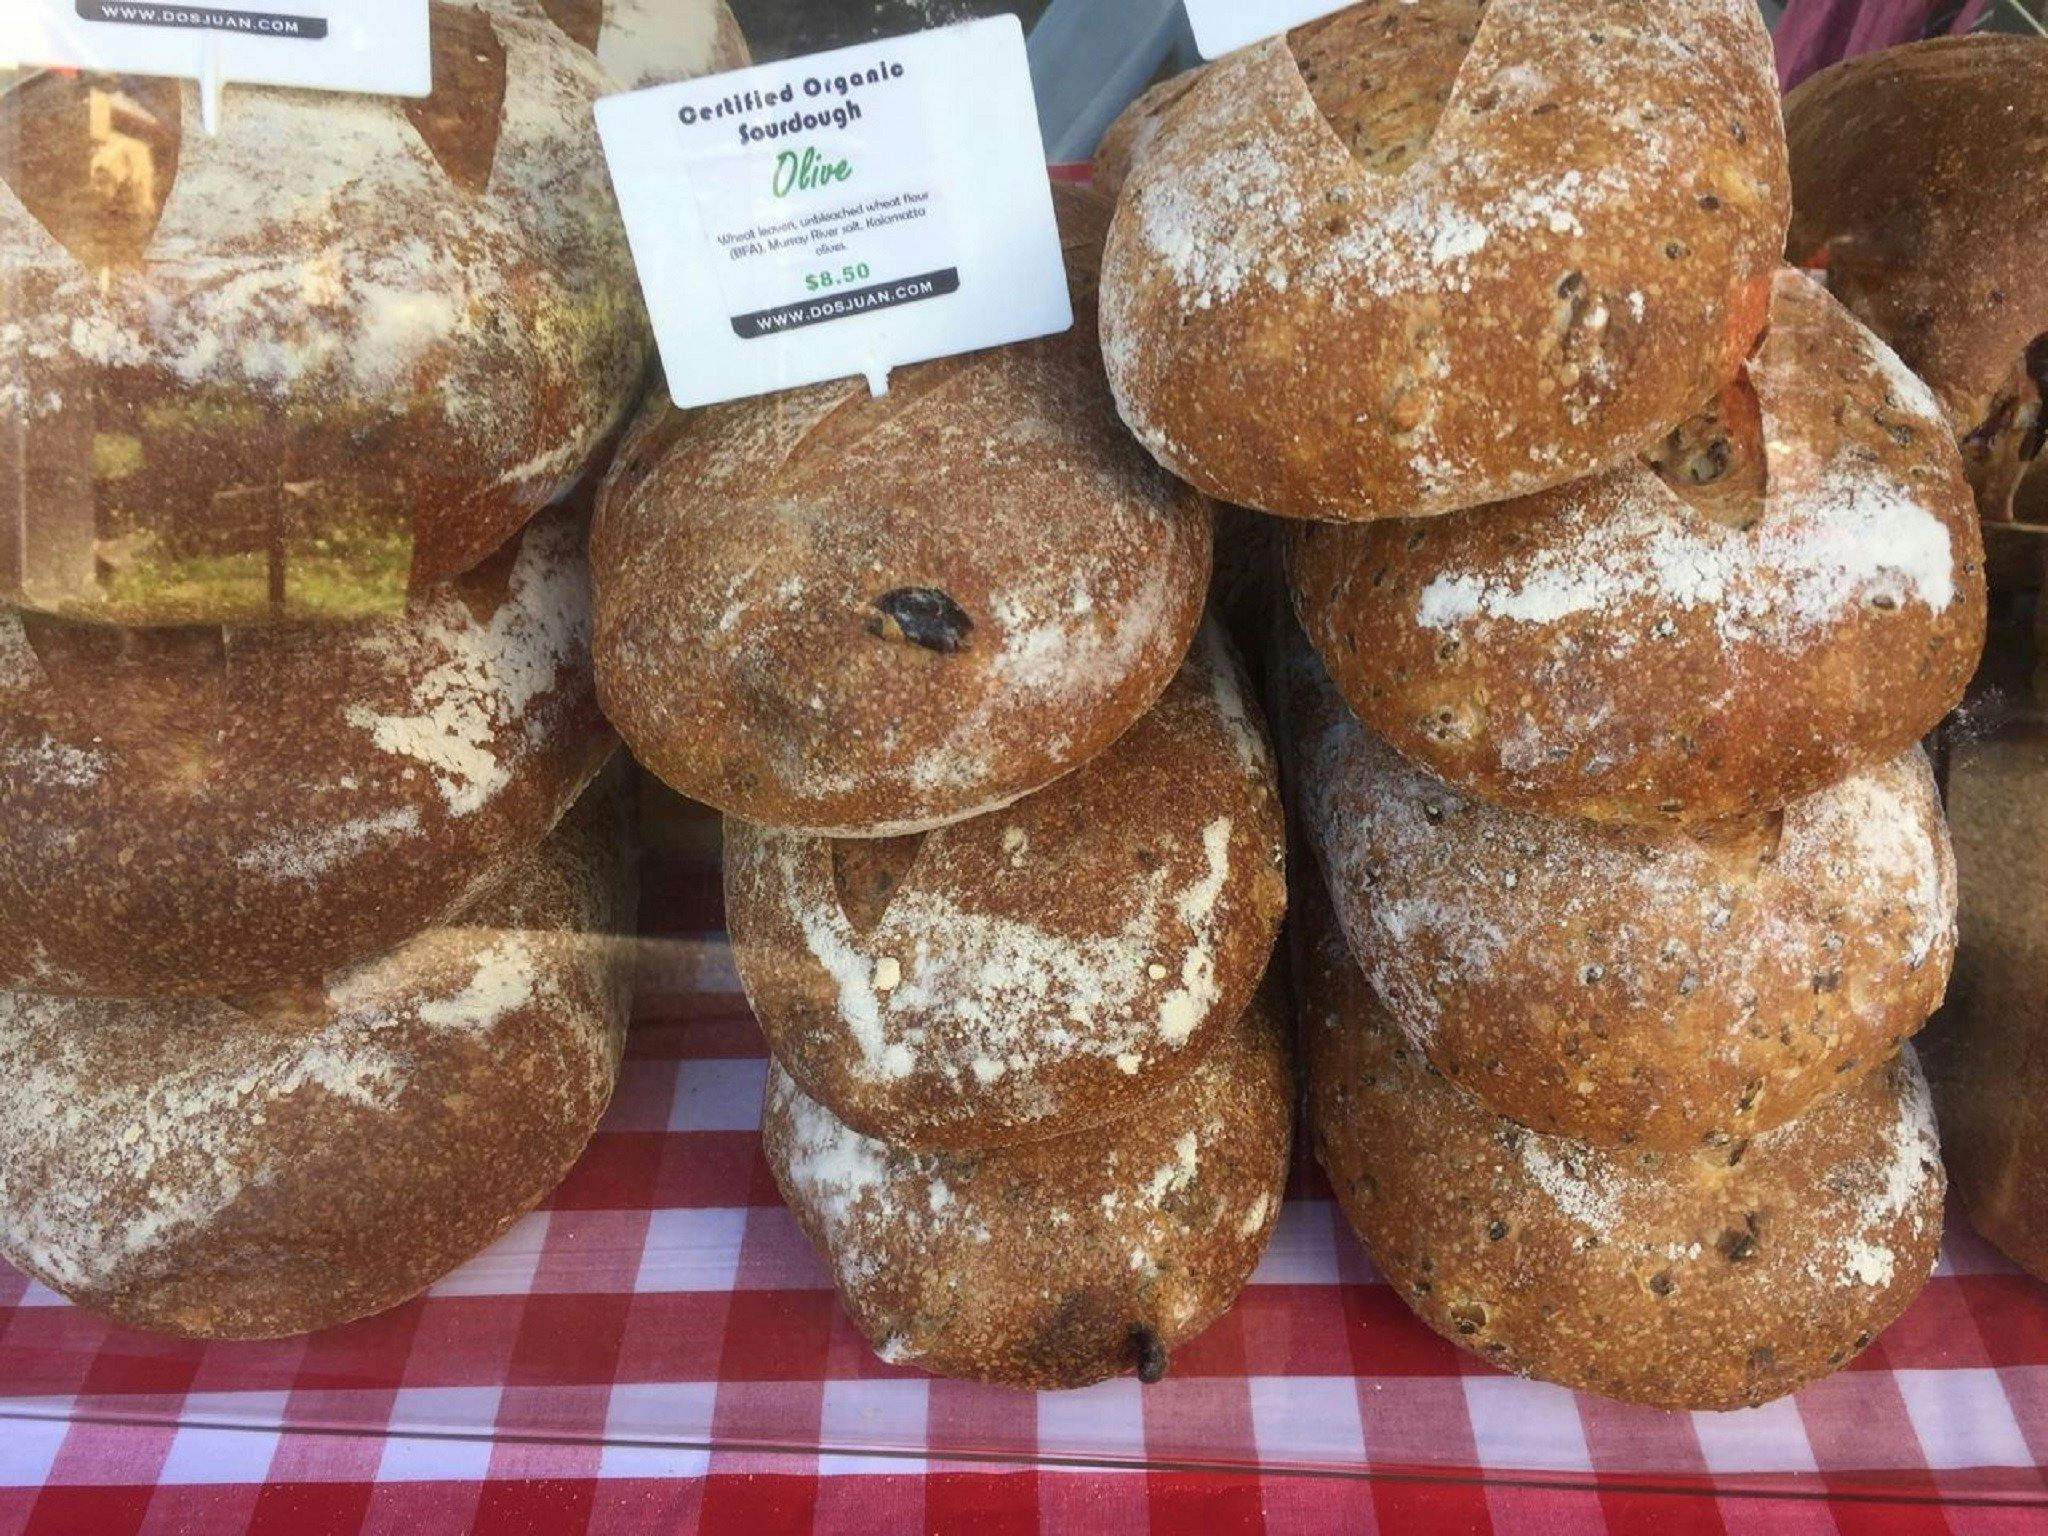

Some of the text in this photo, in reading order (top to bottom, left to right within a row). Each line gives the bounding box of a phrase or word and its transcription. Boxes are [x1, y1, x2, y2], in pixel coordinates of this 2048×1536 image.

[101, 5, 299, 33] WWW.DOSJUAN.COM
[678, 60, 904, 125] Certified Organic
[739, 99, 862, 145] Sourdough
[772, 146, 852, 199] Olive
[717, 228, 755, 246] Wheat
[800, 205, 863, 227] unbleached
[866, 196, 900, 213] wheat
[903, 191, 929, 206] flour
[768, 234, 809, 252] Murray
[810, 227, 838, 241] River
[805, 261, 871, 292] $8.50
[756, 281, 934, 331] WWW.DOSJUAN.COM
